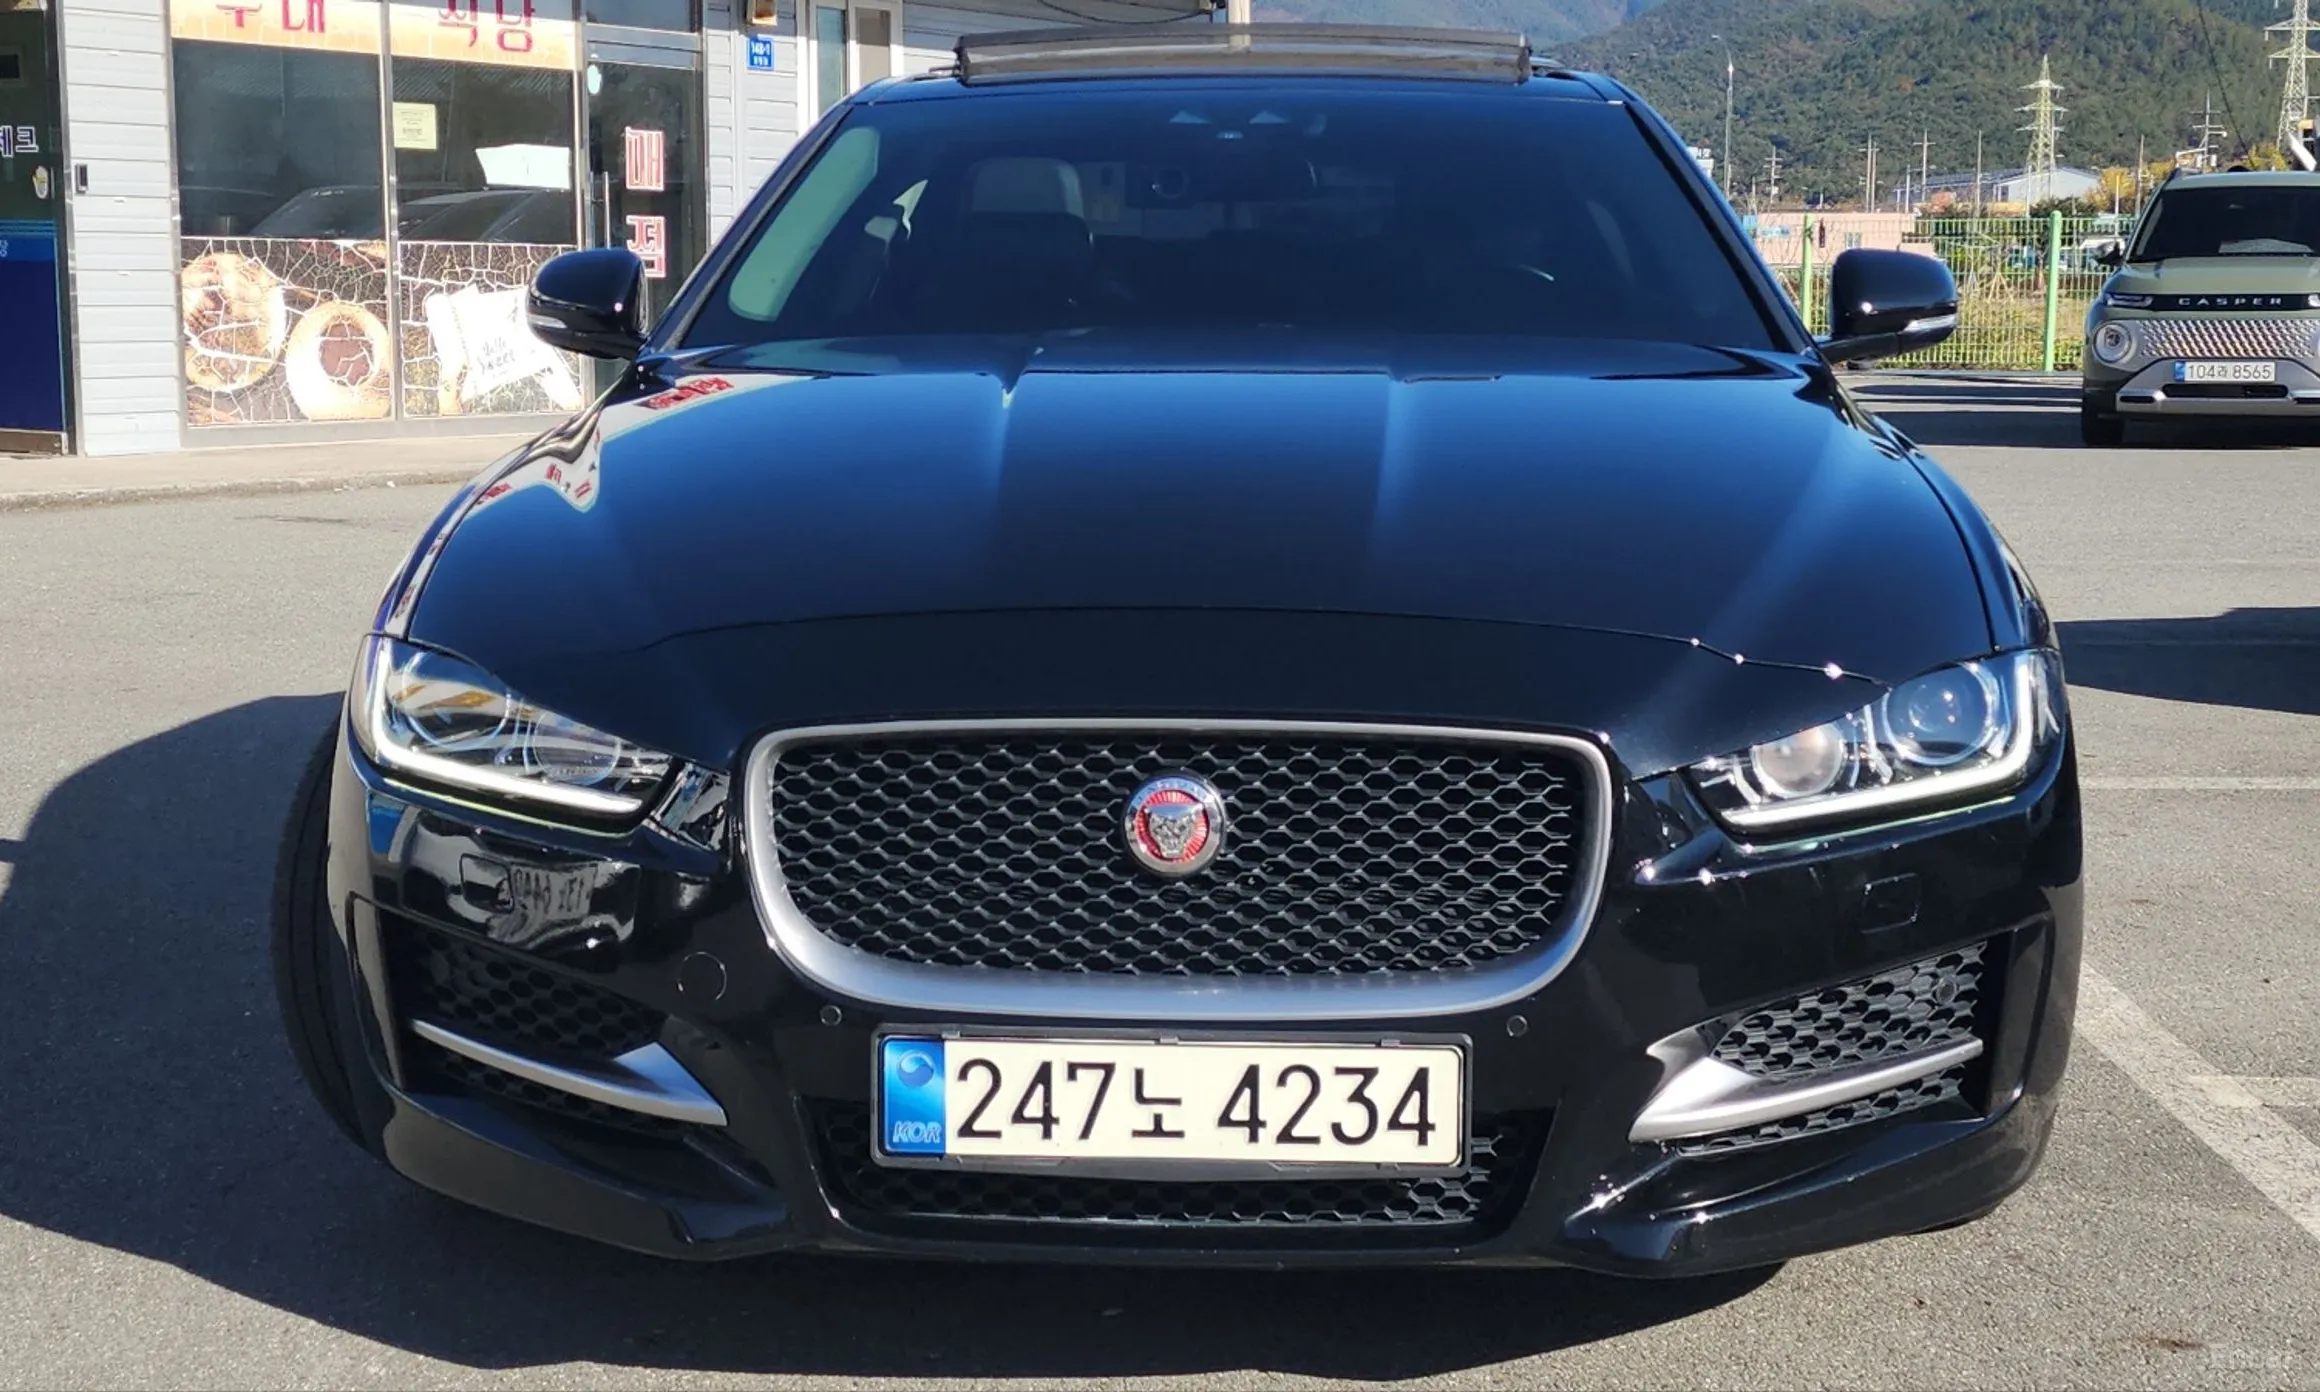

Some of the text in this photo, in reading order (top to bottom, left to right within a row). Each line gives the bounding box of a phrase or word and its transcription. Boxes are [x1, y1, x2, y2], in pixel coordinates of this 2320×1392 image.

[2178, 297, 2282, 306] CASPER
[2233, 364, 2272, 380] 8565
[956, 1057, 1437, 1147] 247노 4234
[892, 1120, 942, 1144] KOR
